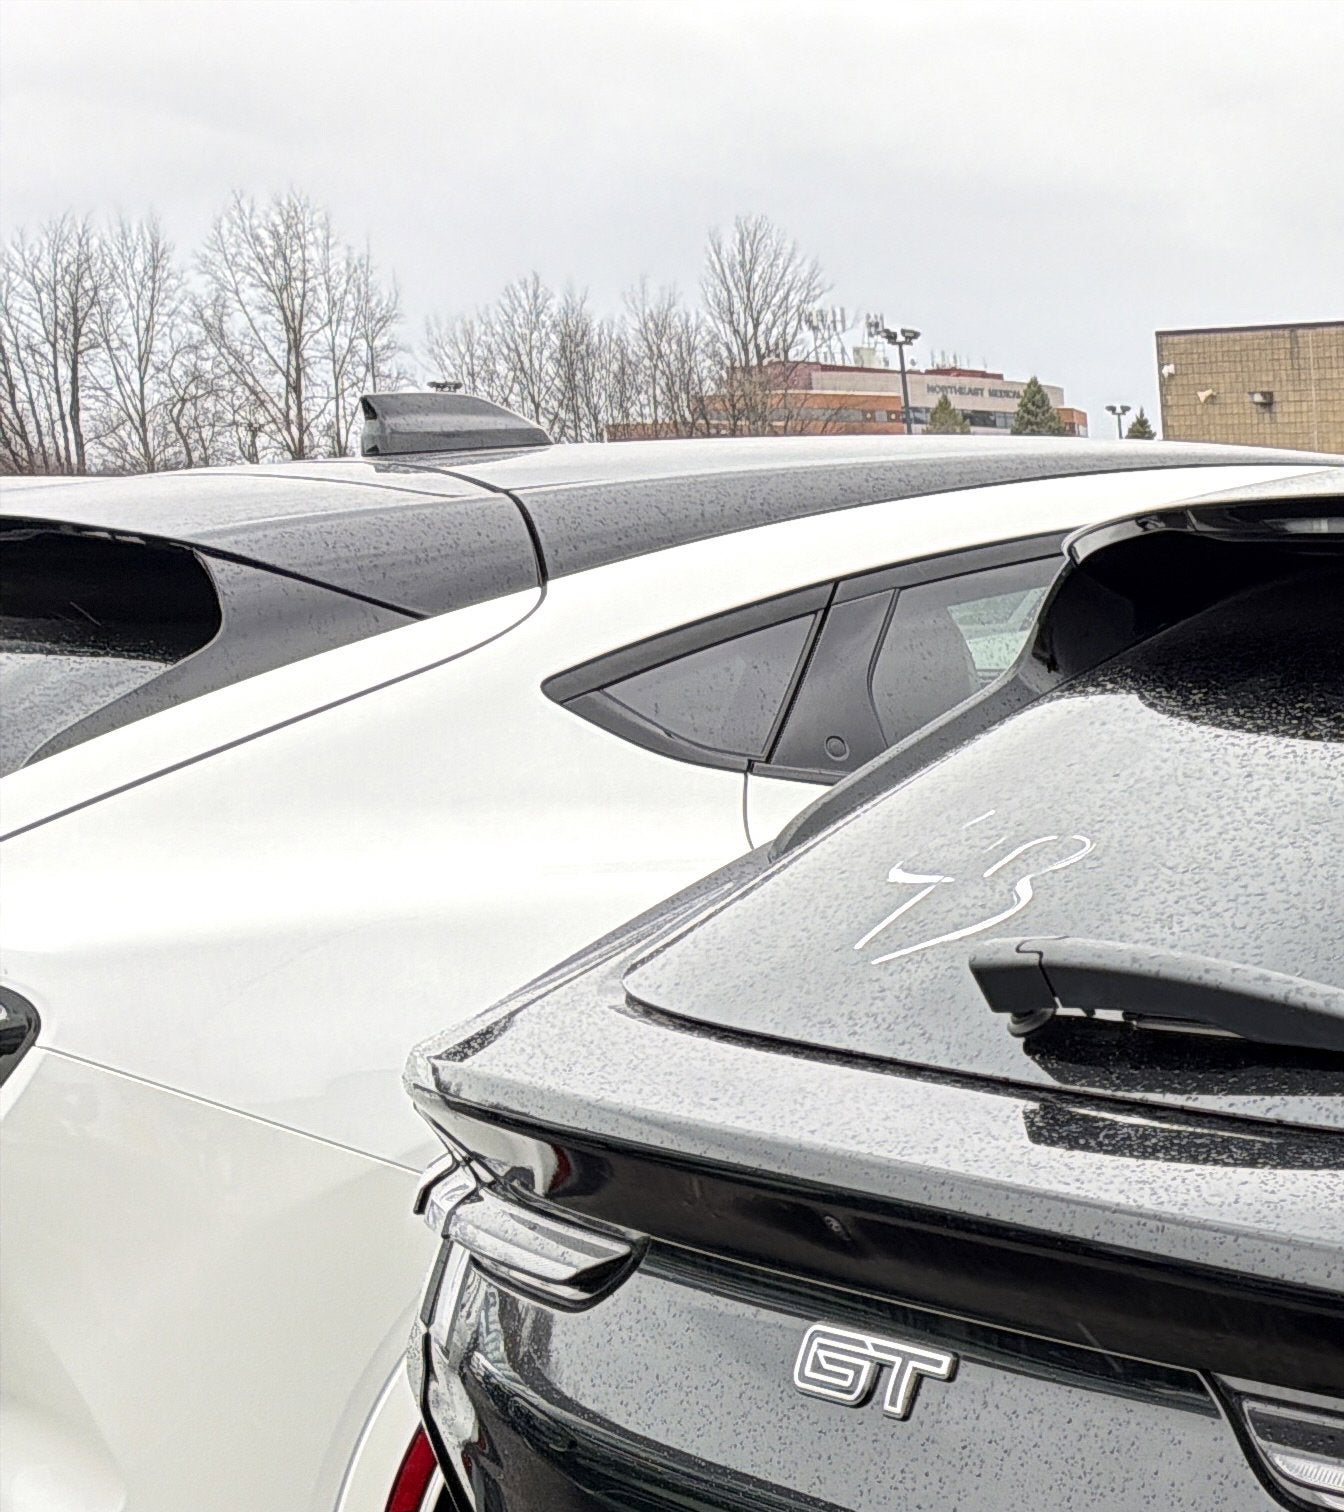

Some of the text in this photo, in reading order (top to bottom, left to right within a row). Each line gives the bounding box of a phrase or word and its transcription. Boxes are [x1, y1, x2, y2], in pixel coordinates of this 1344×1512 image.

[926, 384, 1021, 399] NORTHEAST MEDICA
[853, 835, 1098, 966] 73
[793, 1323, 958, 1420] GT
